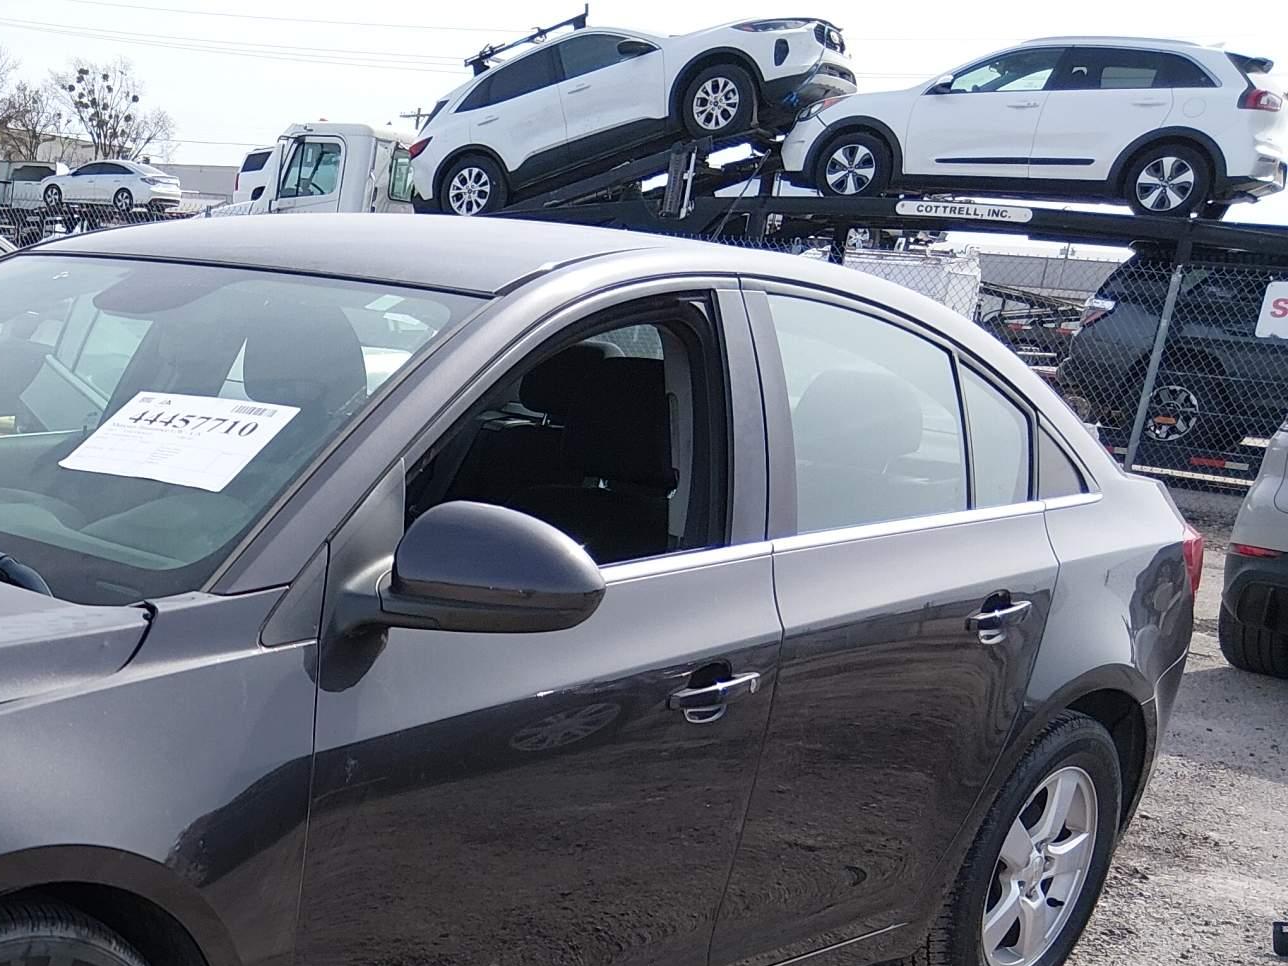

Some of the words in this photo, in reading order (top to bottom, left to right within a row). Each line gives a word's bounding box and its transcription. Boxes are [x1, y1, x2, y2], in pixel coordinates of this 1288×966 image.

[916, 204, 984, 218] COTTRELL,
[987, 208, 1011, 219] INC.
[129, 410, 259, 438] 44457710
